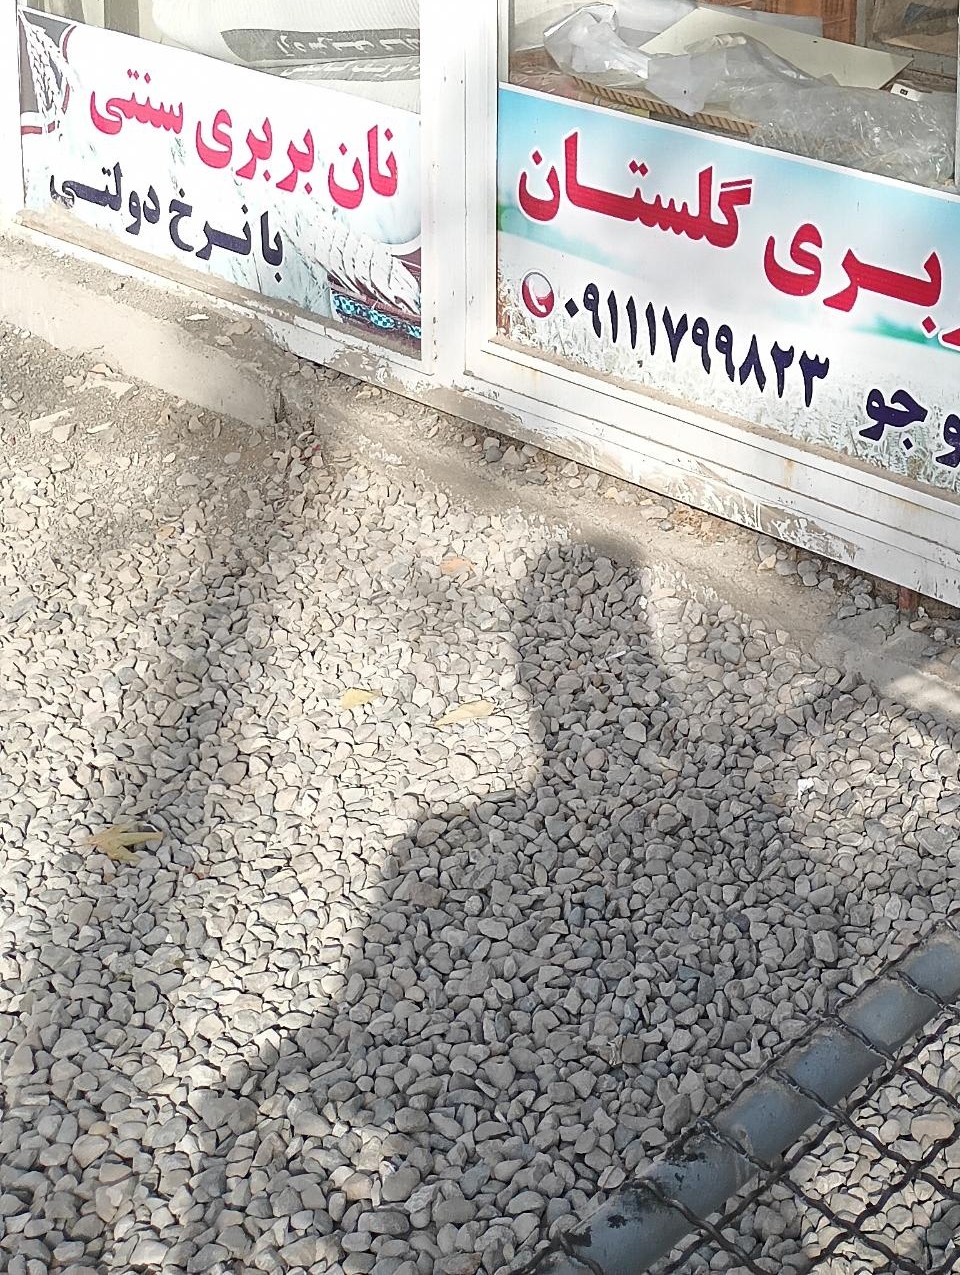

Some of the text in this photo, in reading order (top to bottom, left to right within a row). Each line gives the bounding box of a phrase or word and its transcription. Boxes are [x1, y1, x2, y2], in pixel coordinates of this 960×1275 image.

[90, 68, 399, 210] نان بربری سنتی
[518, 131, 754, 250] گلستان
[50, 162, 285, 281] با نرخ دولتی
[562, 281, 831, 407] ۰۹۱۱۱۷۹۹۸۲۳
[858, 383, 928, 450] جو
